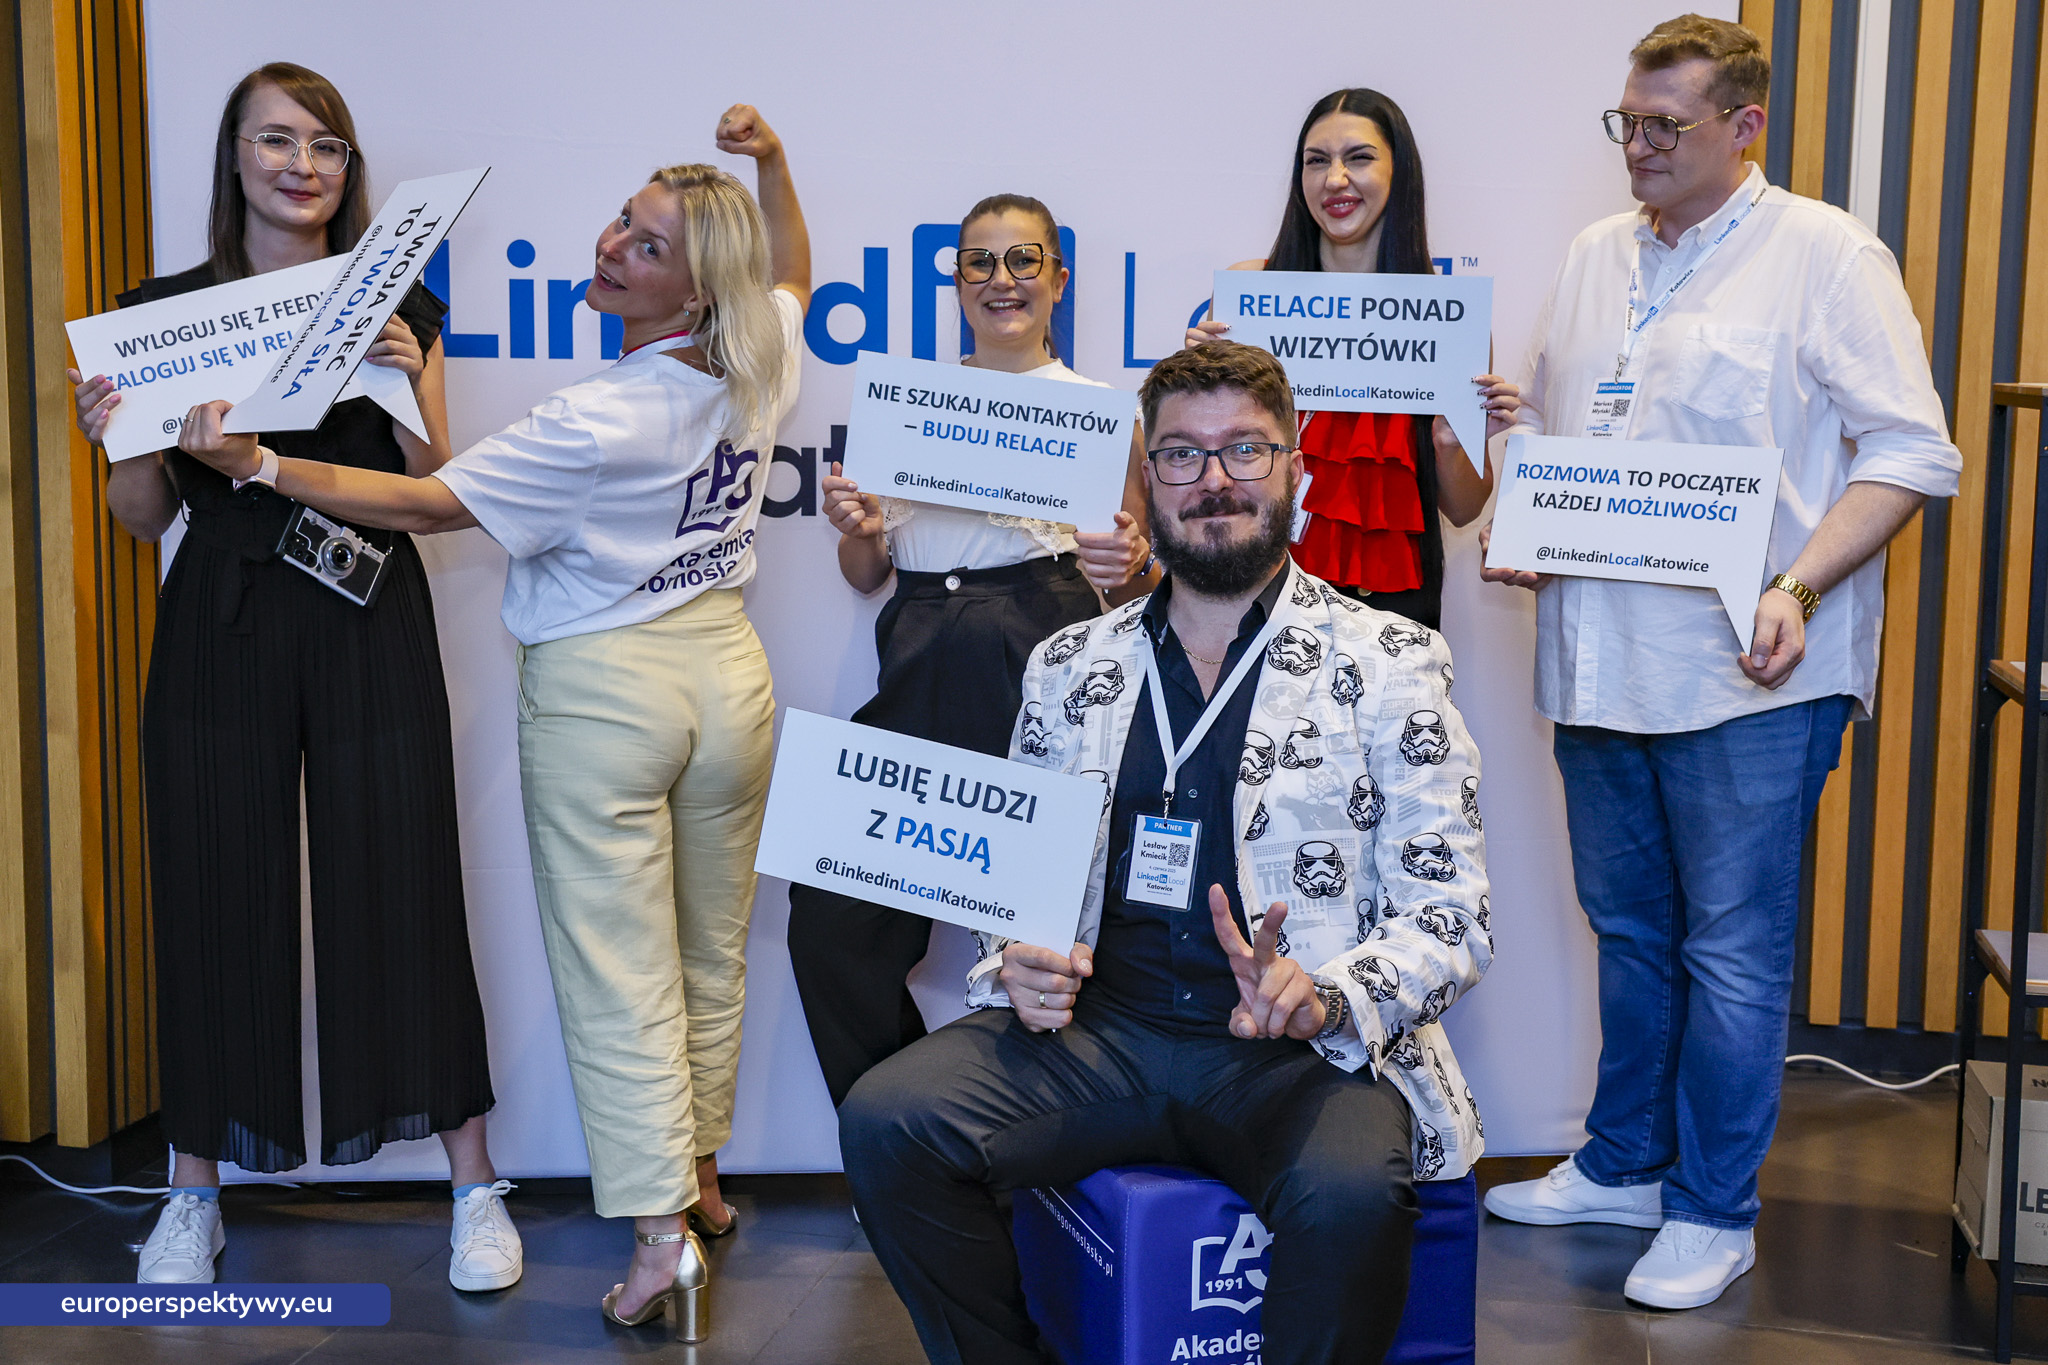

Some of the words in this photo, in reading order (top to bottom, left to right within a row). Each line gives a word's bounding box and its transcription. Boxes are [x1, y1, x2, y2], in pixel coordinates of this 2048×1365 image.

[394, 202, 427, 237] TO
[367, 216, 442, 309] TWOJA
[270, 225, 383, 383] @LinkedinLocalKatowice
[325, 243, 399, 336] TWOJA
[1239, 294, 1351, 319] RELACJE
[1361, 297, 1465, 322] PONAD
[114, 319, 216, 358] WYLOGUJ
[220, 310, 254, 332] SIĘ
[255, 306, 269, 323] Z
[272, 291, 323, 319] FEED
[200, 346, 233, 368] SIĘ
[234, 340, 257, 359] W
[326, 316, 373, 372] SIEĆ
[1269, 332, 1436, 363] WIZYTÓWKI
[281, 343, 330, 400] SIŁA
[867, 382, 902, 403] NIE
[906, 387, 982, 415] SZUKAJ
[986, 400, 1118, 436] KONTAKTÓW
[1290, 384, 1435, 401] nkedinLocalKatowice
[922, 420, 990, 446] BUDUJ
[995, 431, 1078, 460] RELACJE
[893, 471, 1069, 510] @LinkedinLocalKatowice
[1516, 463, 1620, 484] ROZMOWA
[1627, 470, 1653, 487] TO
[1658, 473, 1761, 494] POCZĄTEK
[1533, 490, 1602, 511] KAŻDEJ
[1607, 495, 1737, 521] MOŻLIWOŚCI
[1536, 547, 1709, 572] @LinkedinLocalKatowice
[836, 748, 932, 805] LUBIĘ
[939, 773, 1038, 824] LUDZI
[865, 808, 888, 840] Z
[895, 817, 991, 874] PASJĄ
[1140, 850, 1168, 861] Kmiecik
[1143, 840, 1168, 850] Lesław
[815, 856, 1016, 922] @LinkedinLocalKatowice
[1146, 882, 1173, 892] Katowice
[1205, 1277, 1243, 1293] 1991
